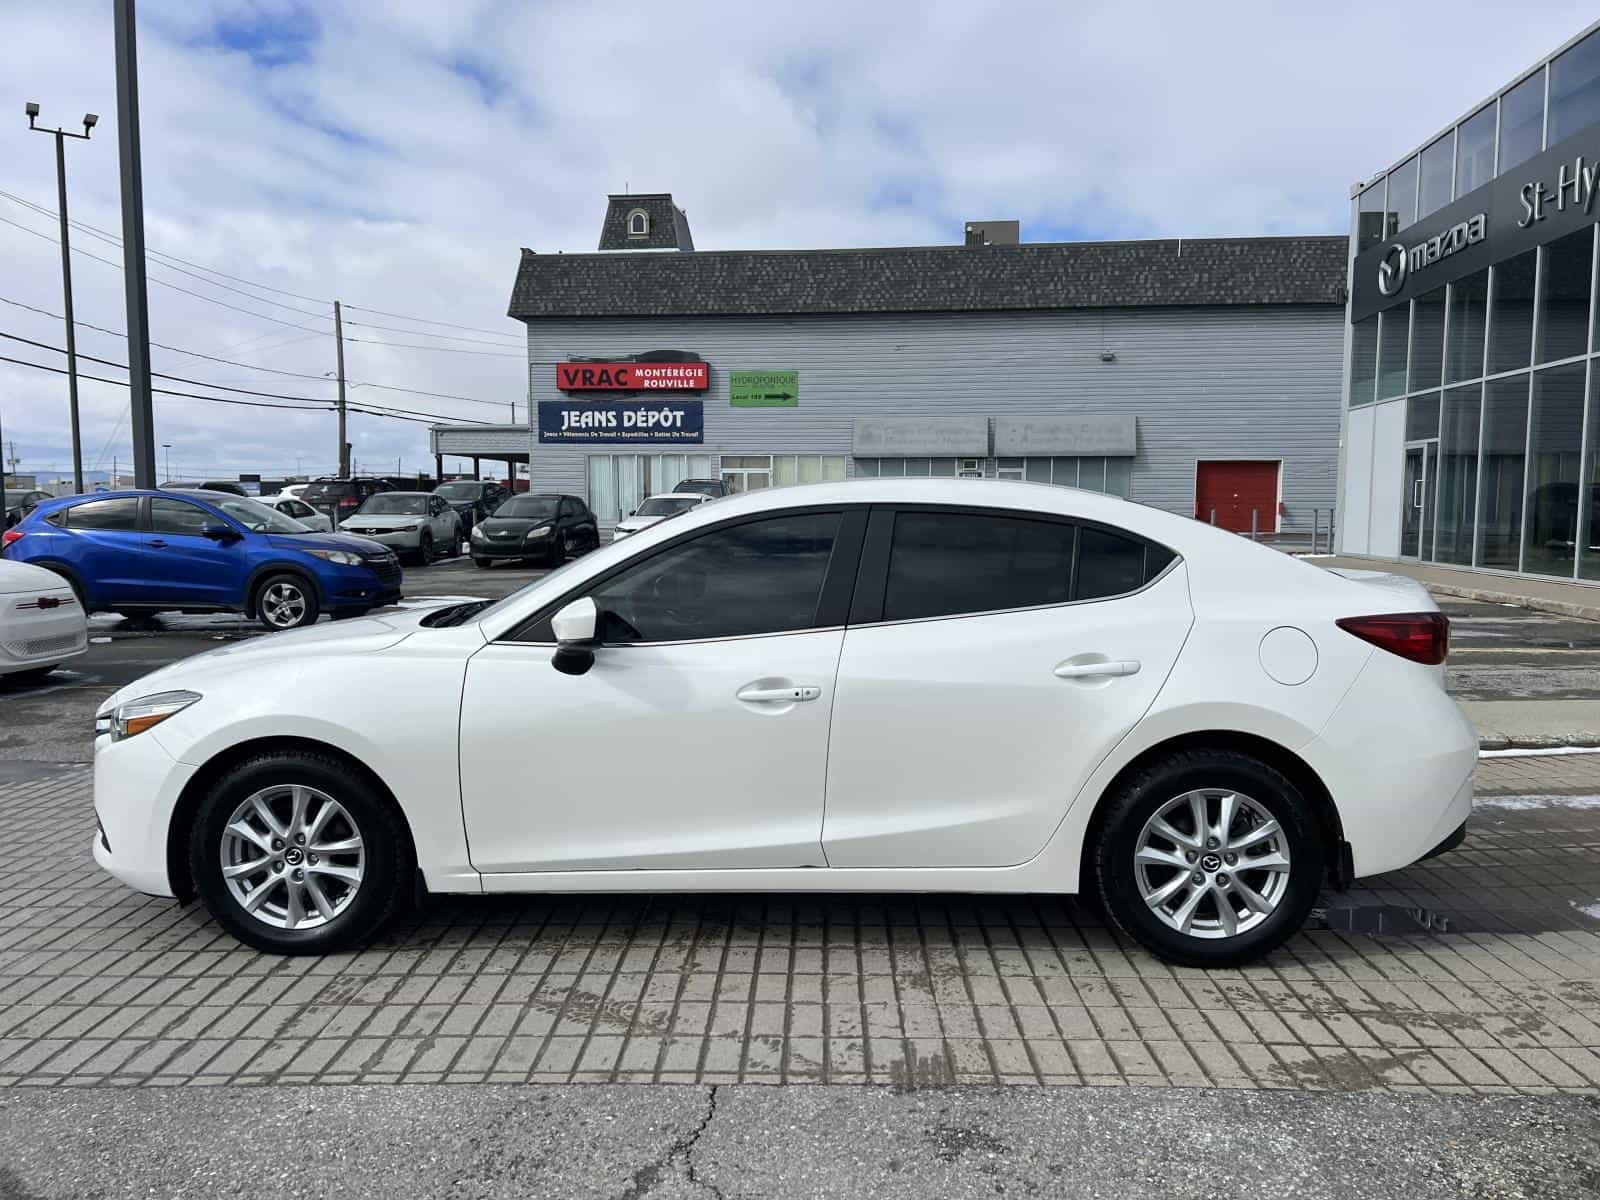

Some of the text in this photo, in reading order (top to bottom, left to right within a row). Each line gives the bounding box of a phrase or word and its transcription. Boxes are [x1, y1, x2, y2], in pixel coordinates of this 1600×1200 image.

[1518, 156, 1600, 227] St-Hy
[1409, 213, 1487, 273] mazda
[563, 369, 628, 386] VRAC
[635, 367, 703, 377] MONTÉRÉGIE
[731, 375, 797, 384] HYDROPONIQUE
[643, 379, 695, 388] ROUVILLE
[561, 407, 685, 430] JEANS DÉPÔT
